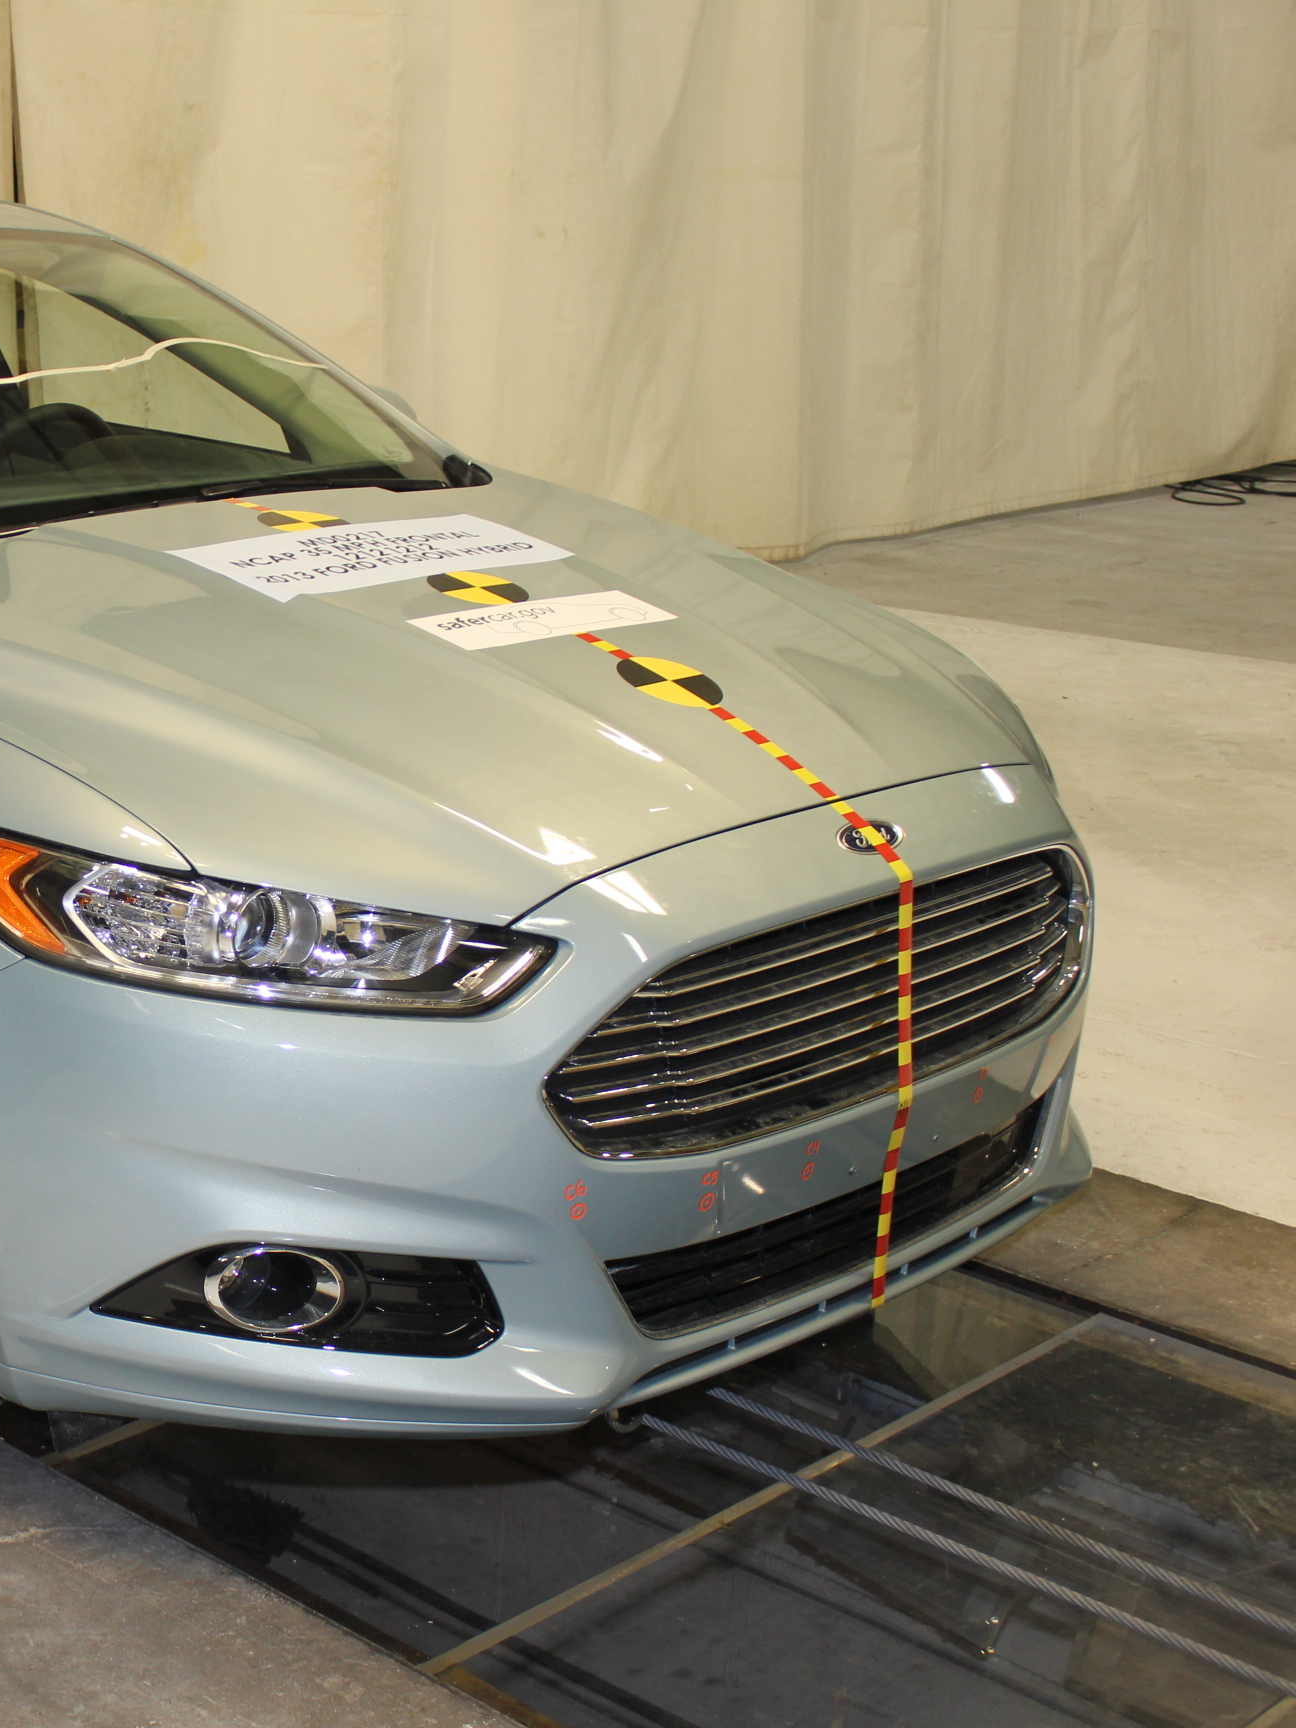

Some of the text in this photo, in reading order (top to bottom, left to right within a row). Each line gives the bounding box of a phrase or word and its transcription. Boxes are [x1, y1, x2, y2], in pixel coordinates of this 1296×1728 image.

[229, 530, 481, 568] NCAP 35 MPH FRONTAL
[296, 530, 385, 547] MD0217
[255, 541, 534, 584] 2013 FORD FUSION HYBRID
[333, 542, 441, 562] 12121212
[437, 606, 556, 631] safercar.gov
[564, 1178, 588, 1201] C6
